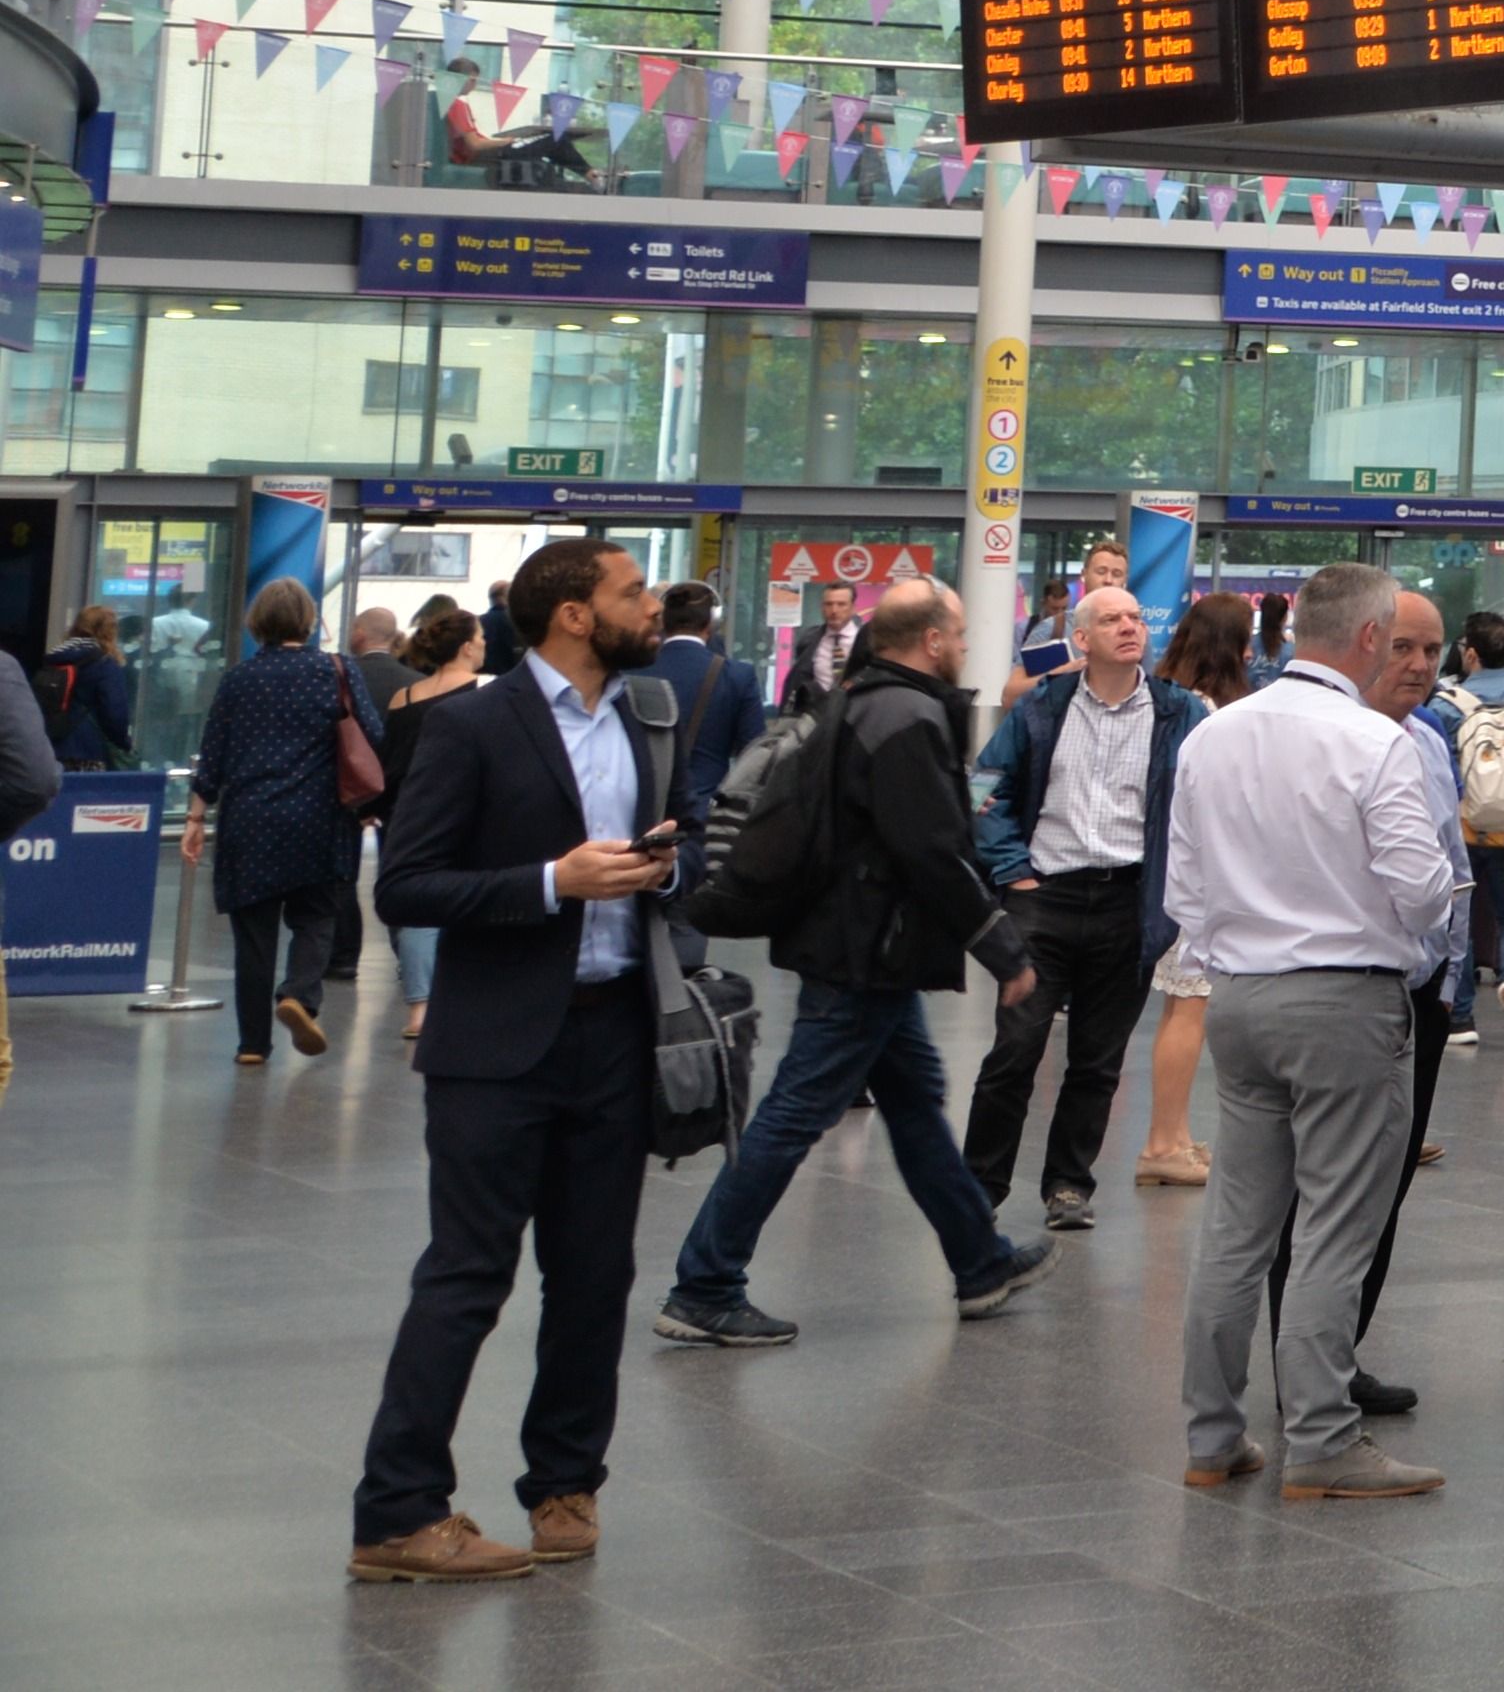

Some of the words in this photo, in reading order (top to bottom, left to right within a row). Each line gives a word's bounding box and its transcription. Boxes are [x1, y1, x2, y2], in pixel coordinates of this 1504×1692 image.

[457, 234, 487, 251] Way
[488, 237, 509, 250] out
[684, 244, 725, 259] Toilets
[683, 267, 728, 283] Oxford
[731, 269, 746, 283] Rd
[748, 269, 775, 284] Link
[1282, 265, 1315, 283] Way
[1318, 268, 1344, 282] out
[1472, 278, 1495, 292] Free
[1272, 297, 1297, 310] Taxis
[1300, 300, 1318, 310] are
[1320, 298, 1366, 312] available
[1368, 301, 1380, 312] at
[1382, 300, 1424, 314] Fairfield
[1427, 301, 1460, 315] Street
[1462, 303, 1483, 316] exit
[1485, 305, 1492, 316] 2
[517, 452, 566, 472] EXIT
[1360, 472, 1403, 488] EXIT
[8, 837, 57, 862] on
